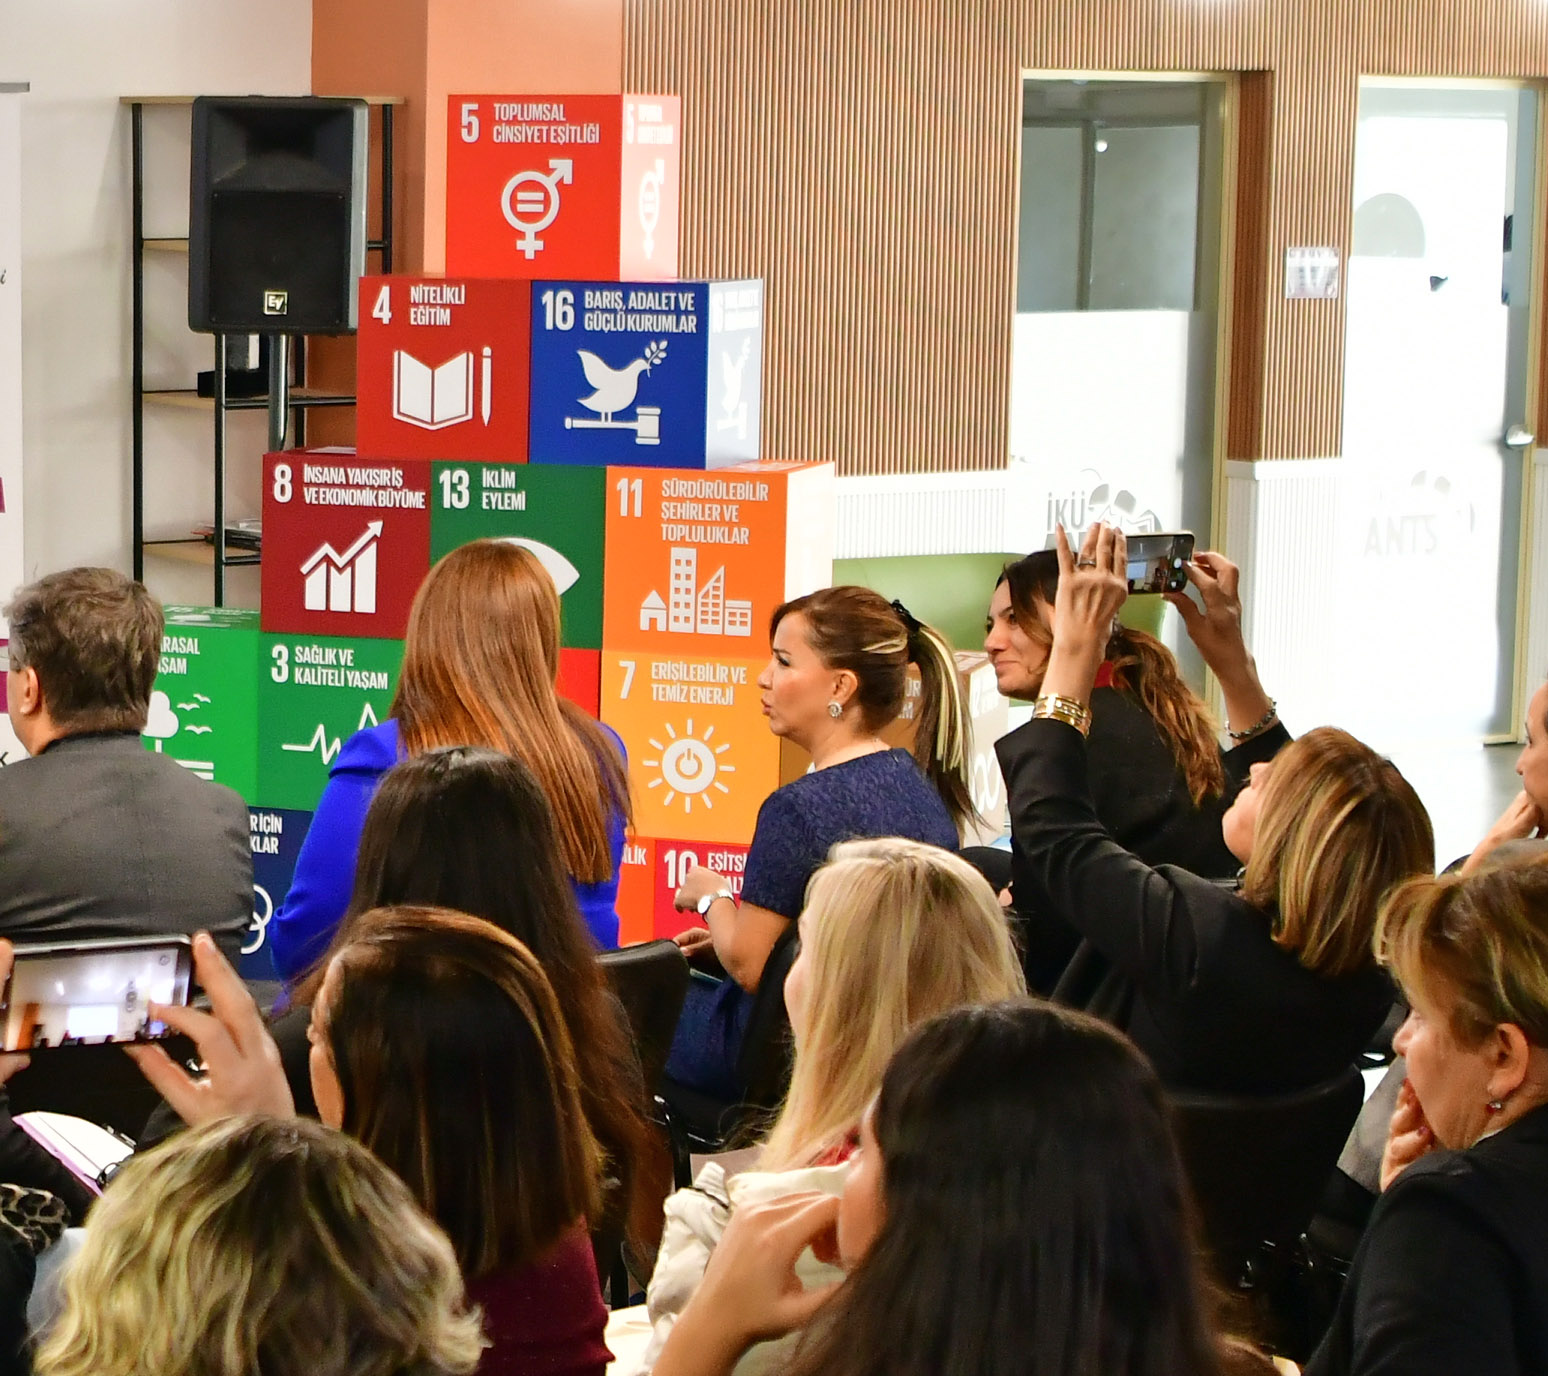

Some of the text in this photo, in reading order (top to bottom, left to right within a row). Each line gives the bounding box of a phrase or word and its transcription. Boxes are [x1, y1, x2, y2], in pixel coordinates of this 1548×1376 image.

[461, 104, 479, 143] 5
[493, 103, 565, 121] TOPLUMSAL
[493, 124, 600, 145] CİNSİYET EŞİTLİĞİ
[372, 286, 392, 324] 4
[410, 284, 465, 304] NİTELİKLİ
[585, 291, 694, 311] BARIŞ, ADALET VE
[410, 306, 451, 326] EĞİTİM
[542, 290, 575, 330] 16
[585, 310, 697, 333] GÜÇLÜ KURUMLAR
[273, 464, 292, 503] 8
[303, 464, 403, 488] İNSANA YAKIŞIR İŞ
[482, 468, 515, 489] İKLİM
[304, 488, 425, 509] VE EKONOMİK BÜYÜME
[439, 469, 469, 509] 13
[482, 490, 525, 511] EYLEMİ
[617, 478, 642, 517] 11
[662, 478, 768, 501] SÜRDÜRÜLEBİLİR
[661, 501, 739, 522] ŞEHİRLER VE
[1047, 491, 1085, 531] İKÜ
[661, 524, 749, 544] TOPLULUKLAR
[271, 644, 289, 683] 3
[295, 644, 354, 666] SAĞLIK VE
[295, 667, 388, 690] KALİTELİ YAŞAM
[619, 660, 636, 699] 7
[651, 661, 747, 684] ERİŞİLEBİLİR VE
[651, 683, 734, 706] TEMİZ ENERJİ
